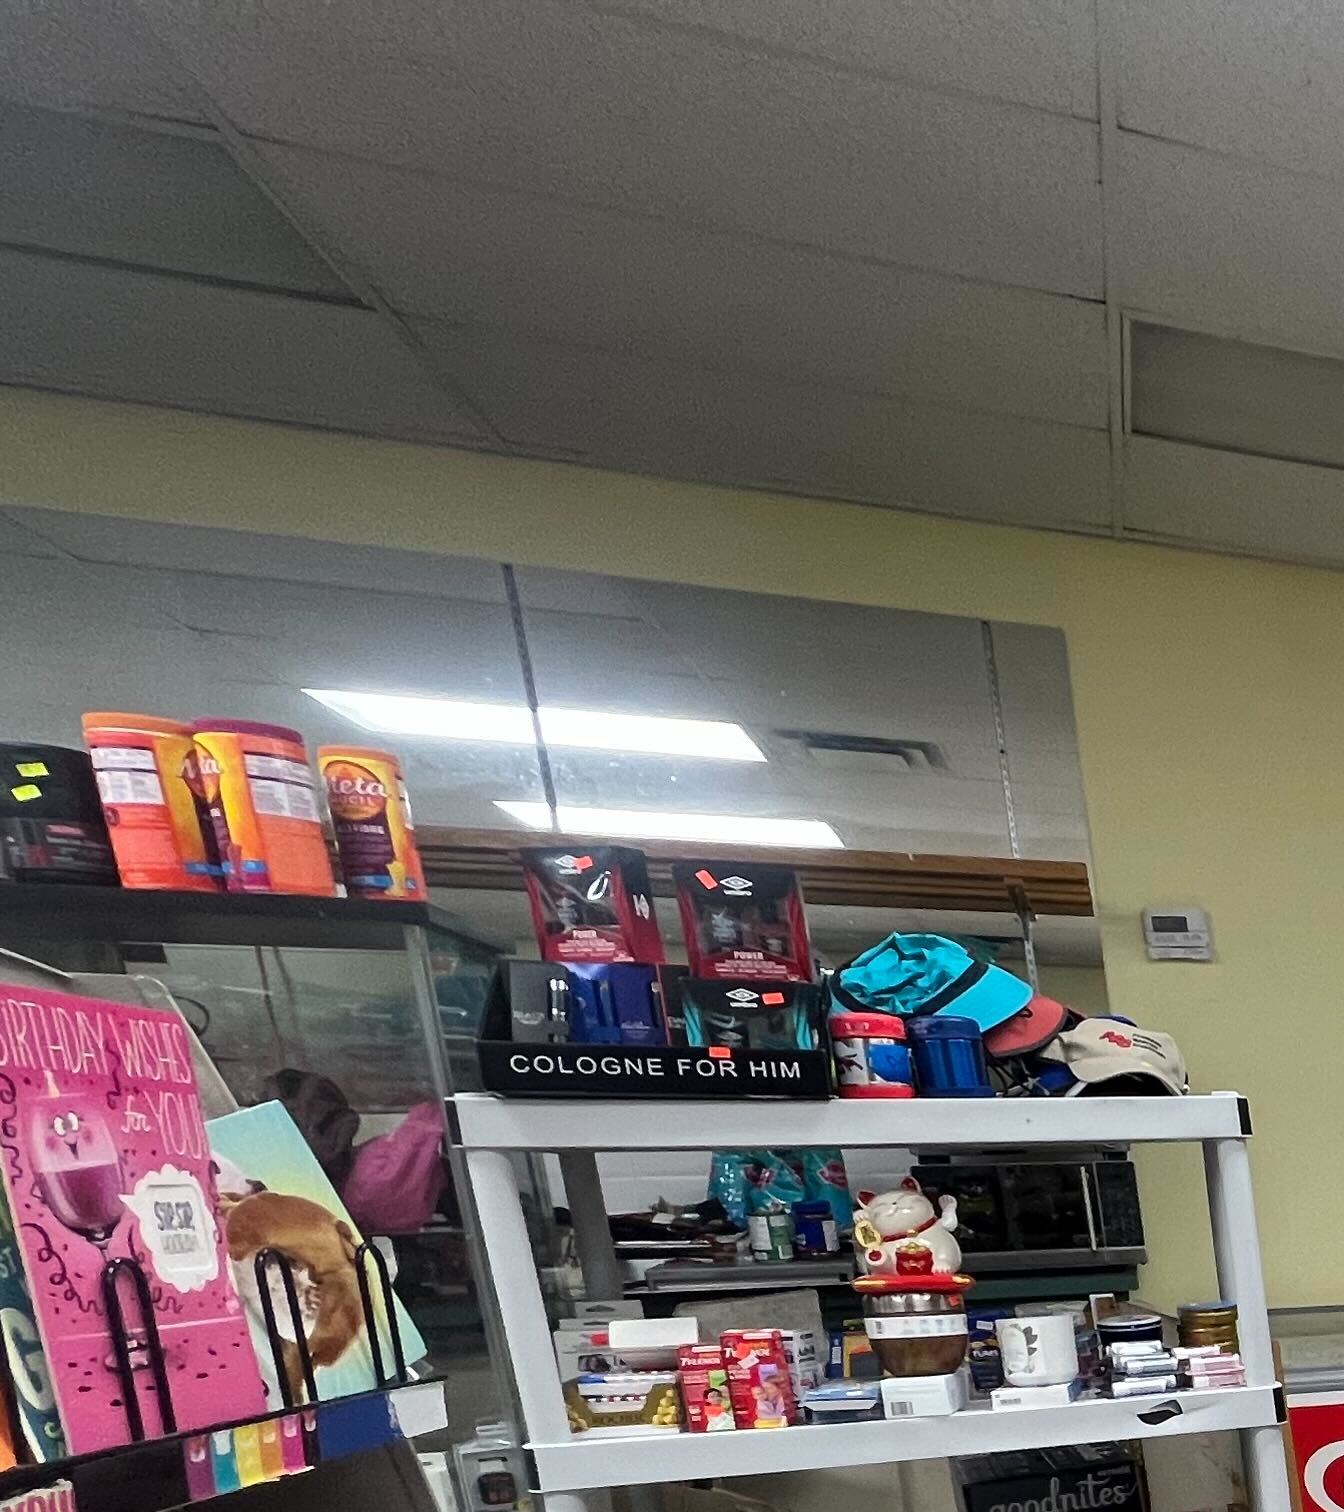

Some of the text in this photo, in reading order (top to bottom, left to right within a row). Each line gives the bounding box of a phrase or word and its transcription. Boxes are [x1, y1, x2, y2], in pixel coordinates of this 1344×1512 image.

[733, 950, 764, 961] POWER
[107, 1012, 192, 1085] WISHES
[510, 1053, 801, 1079] COLOGNE FOR HIM
[121, 1095, 151, 1133] for
